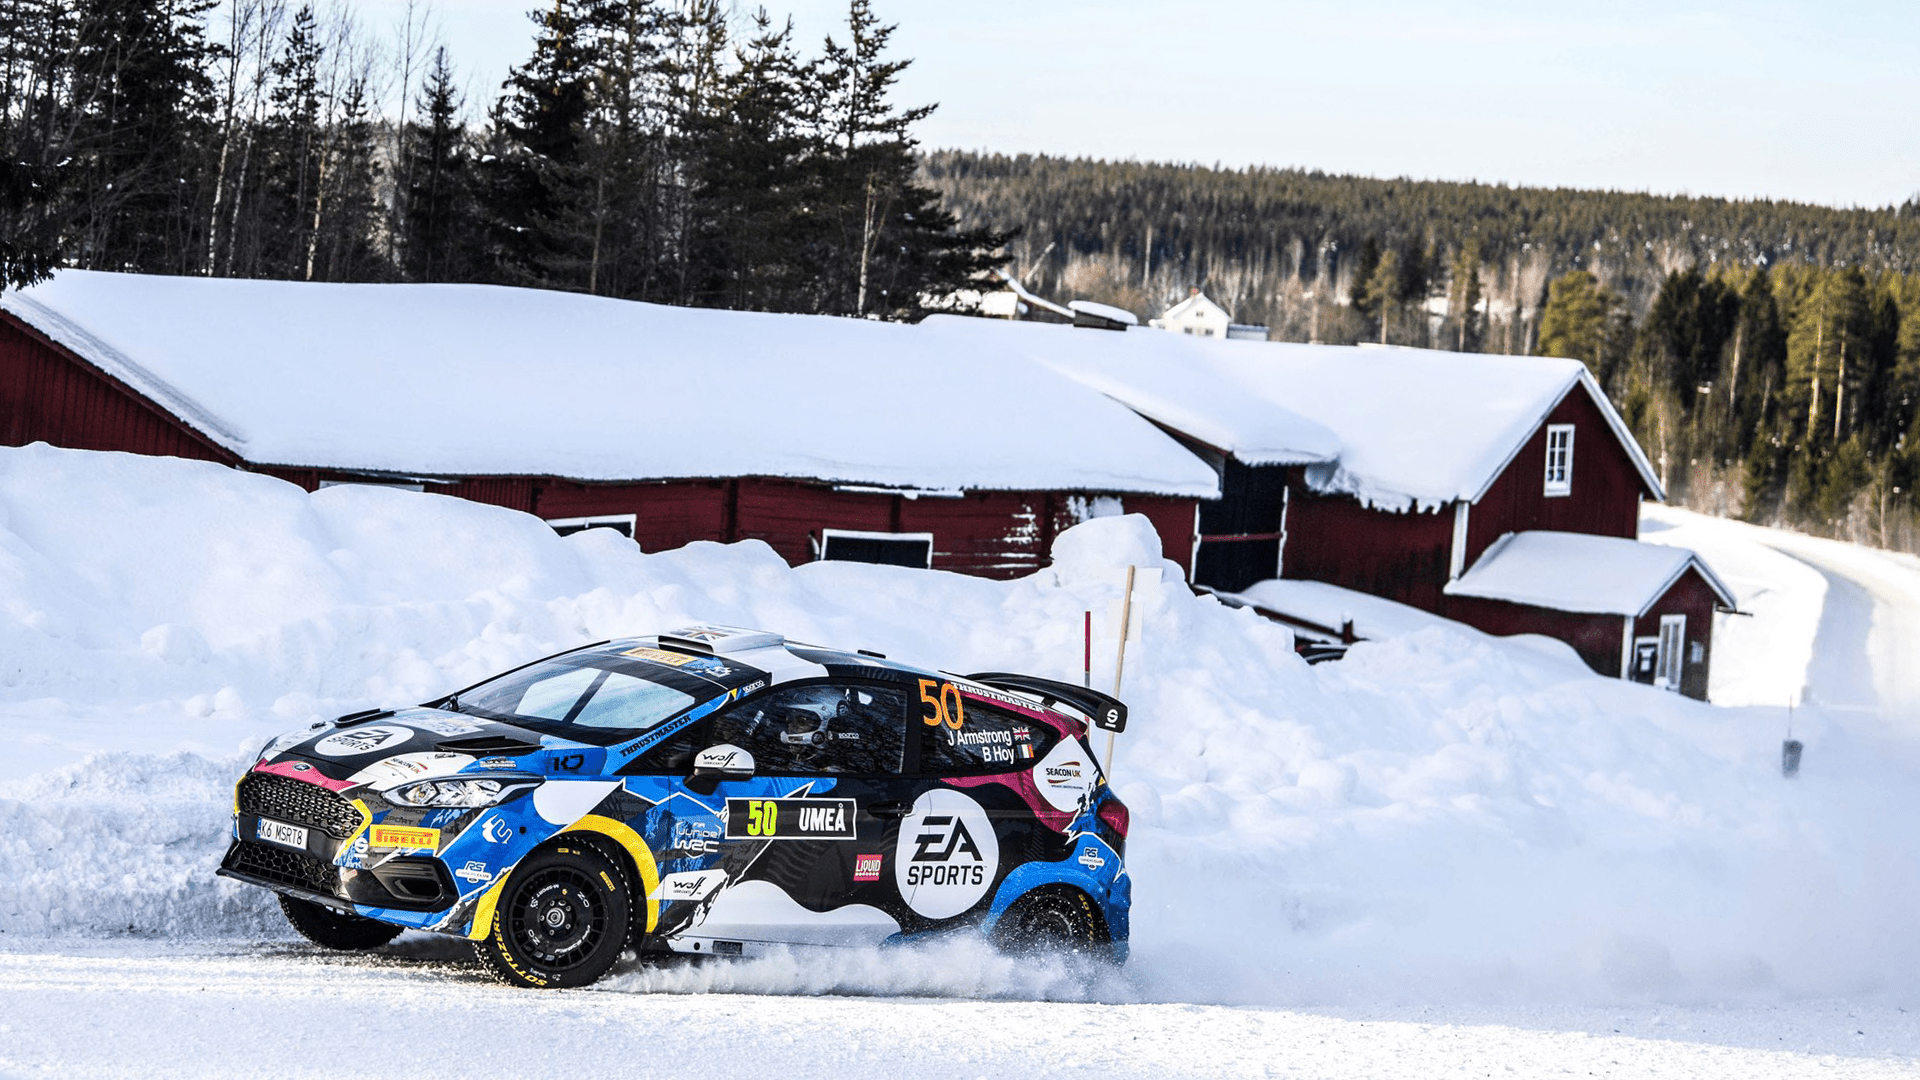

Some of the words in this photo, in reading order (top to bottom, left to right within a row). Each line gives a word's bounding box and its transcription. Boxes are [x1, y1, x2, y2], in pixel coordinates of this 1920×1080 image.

[918, 678, 964, 730] 50
[950, 681, 1045, 713] THRUSTMASTER
[619, 713, 691, 758] THRUSTMASTER
[947, 730, 955, 746] J
[957, 729, 1012, 746] Armstrong
[982, 746, 992, 762] B
[993, 746, 1014, 764] Hoy
[747, 800, 778, 836] 50
[798, 803, 847, 832] UMEÅ
[261, 820, 272, 838] K6
[274, 825, 303, 846] MSRT8
[375, 828, 434, 846] PIRELLI
[910, 816, 984, 862] EA
[674, 837, 720, 853] WRC
[466, 862, 485, 871] RS
[855, 860, 881, 873] LIQUID
[907, 865, 984, 886] SPORTS
[493, 909, 548, 986] SOTTOZERO
